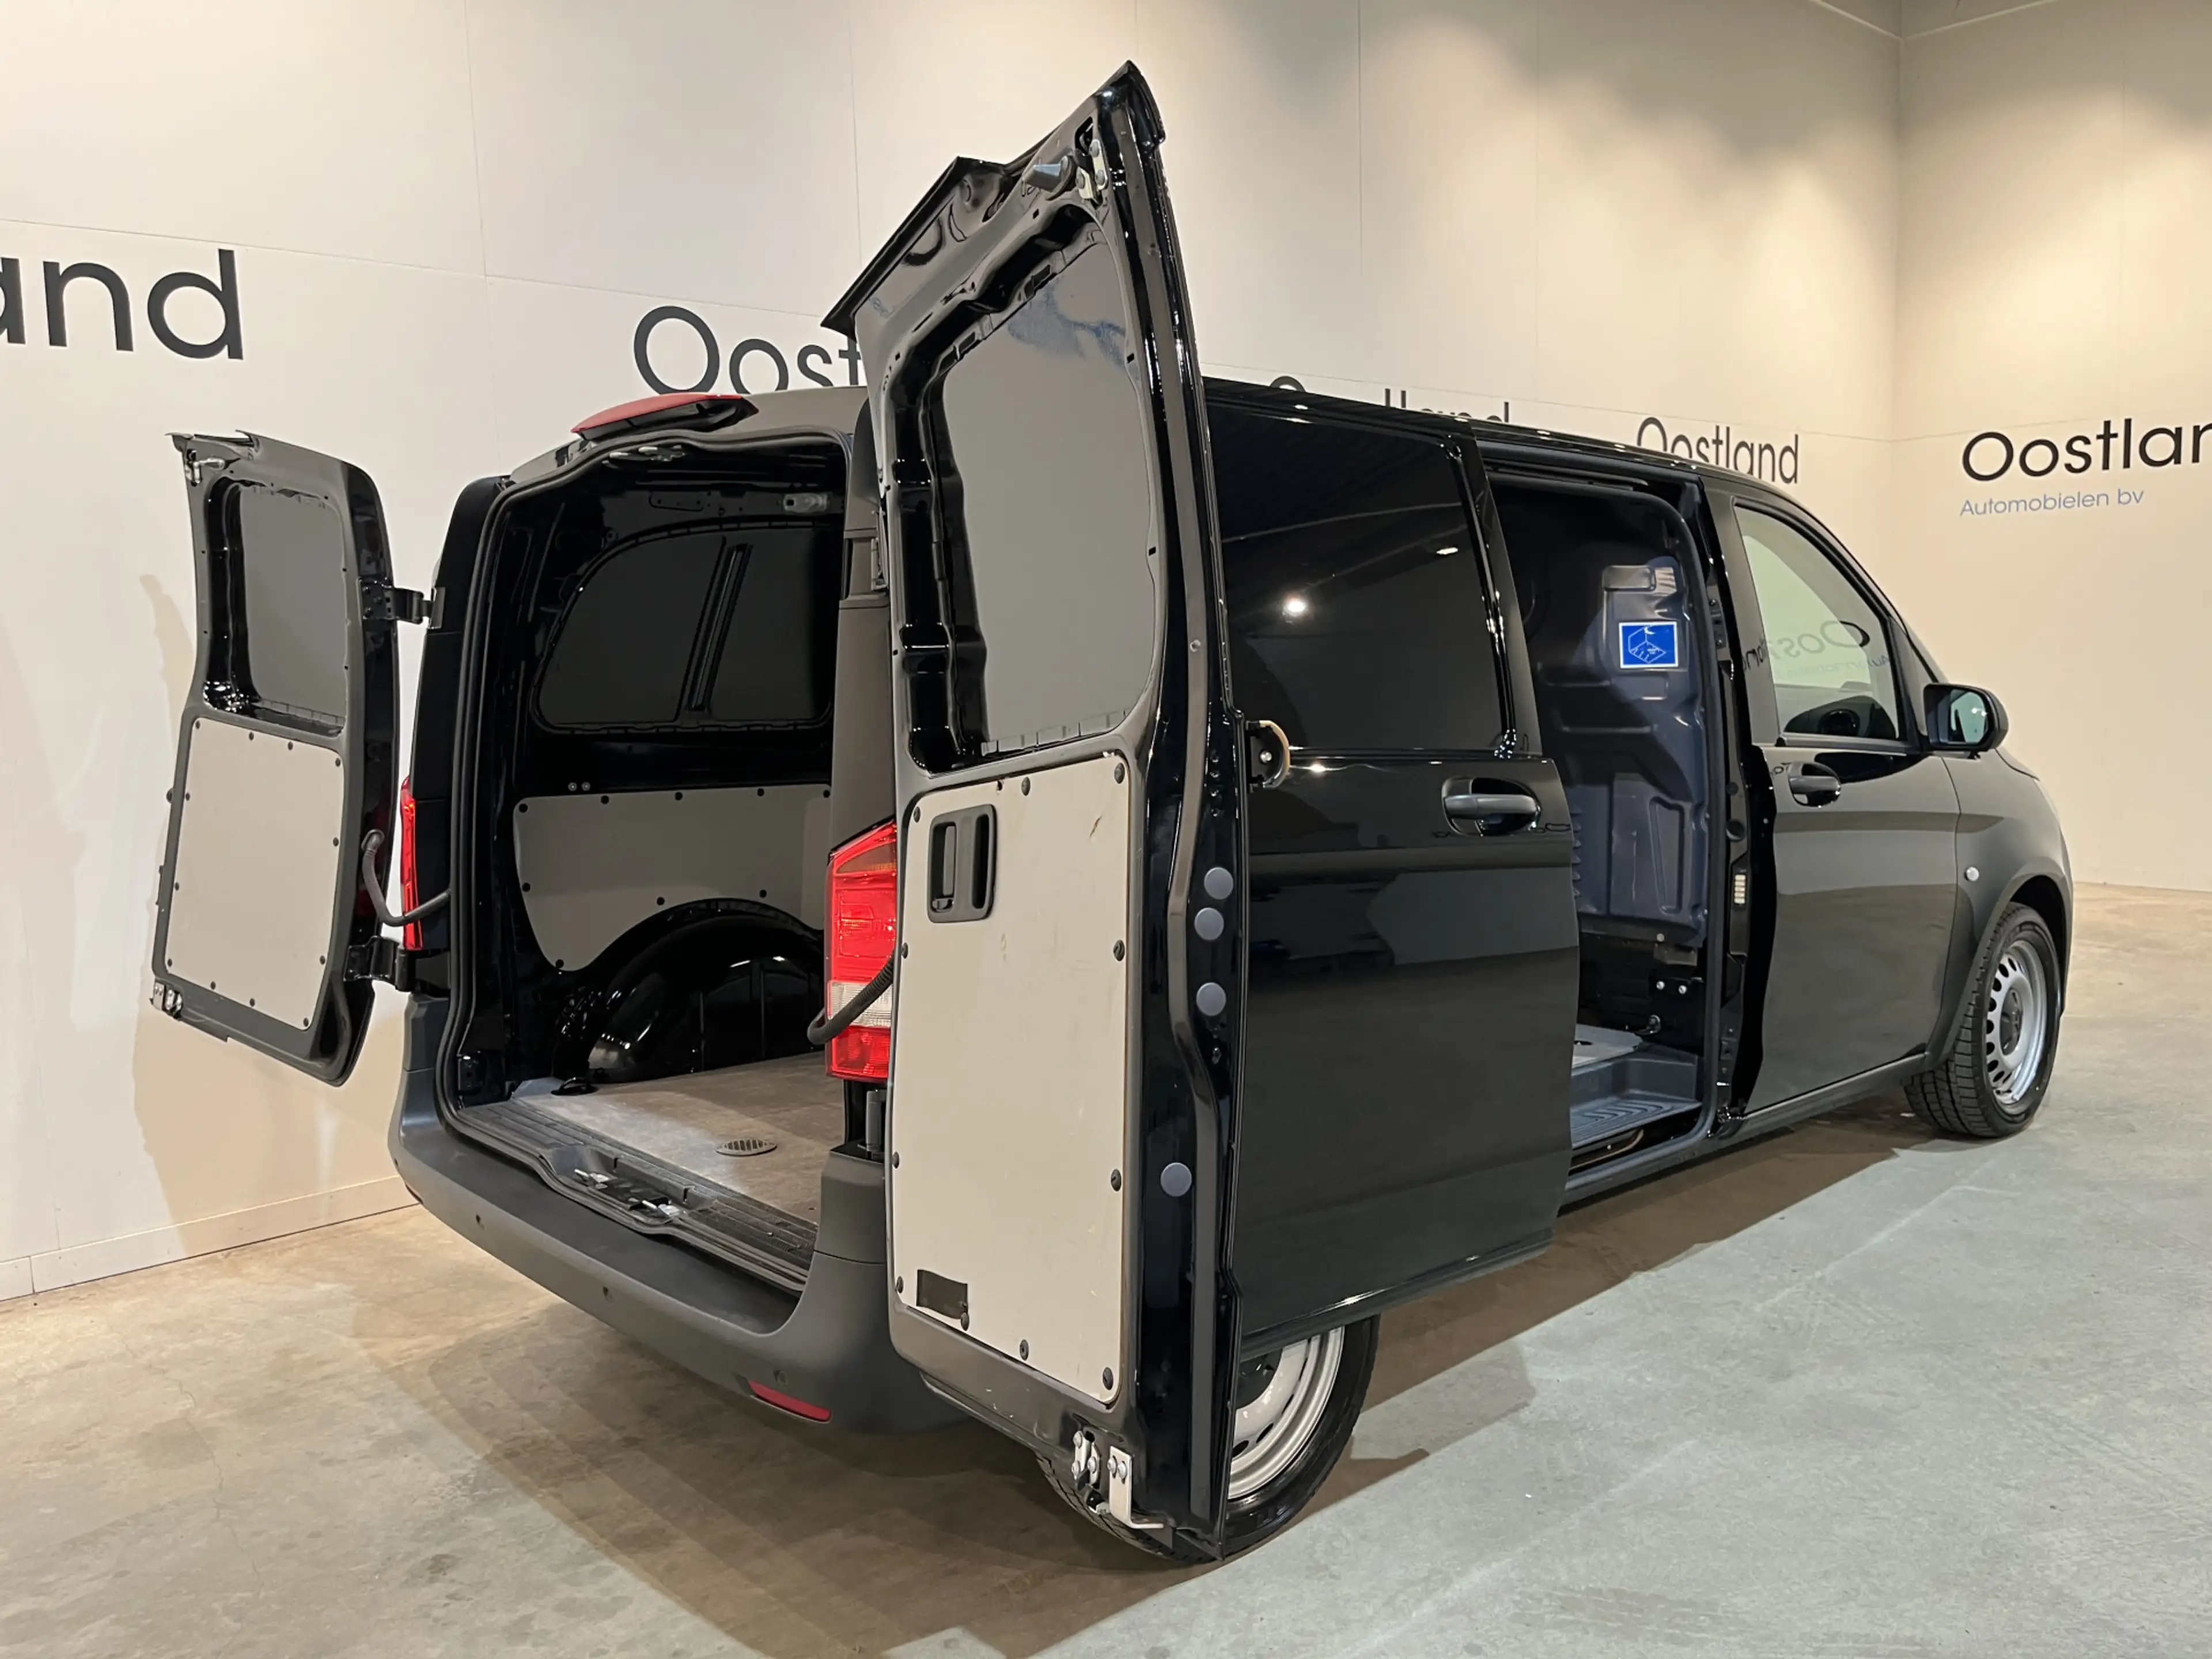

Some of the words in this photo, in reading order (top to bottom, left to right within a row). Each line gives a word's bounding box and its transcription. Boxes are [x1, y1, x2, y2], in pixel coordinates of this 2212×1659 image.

[0, 248, 244, 360] nd
[1637, 417, 1798, 484] Oostland
[1960, 492, 2109, 516] Automobielen
[2118, 488, 2144, 505] bv
